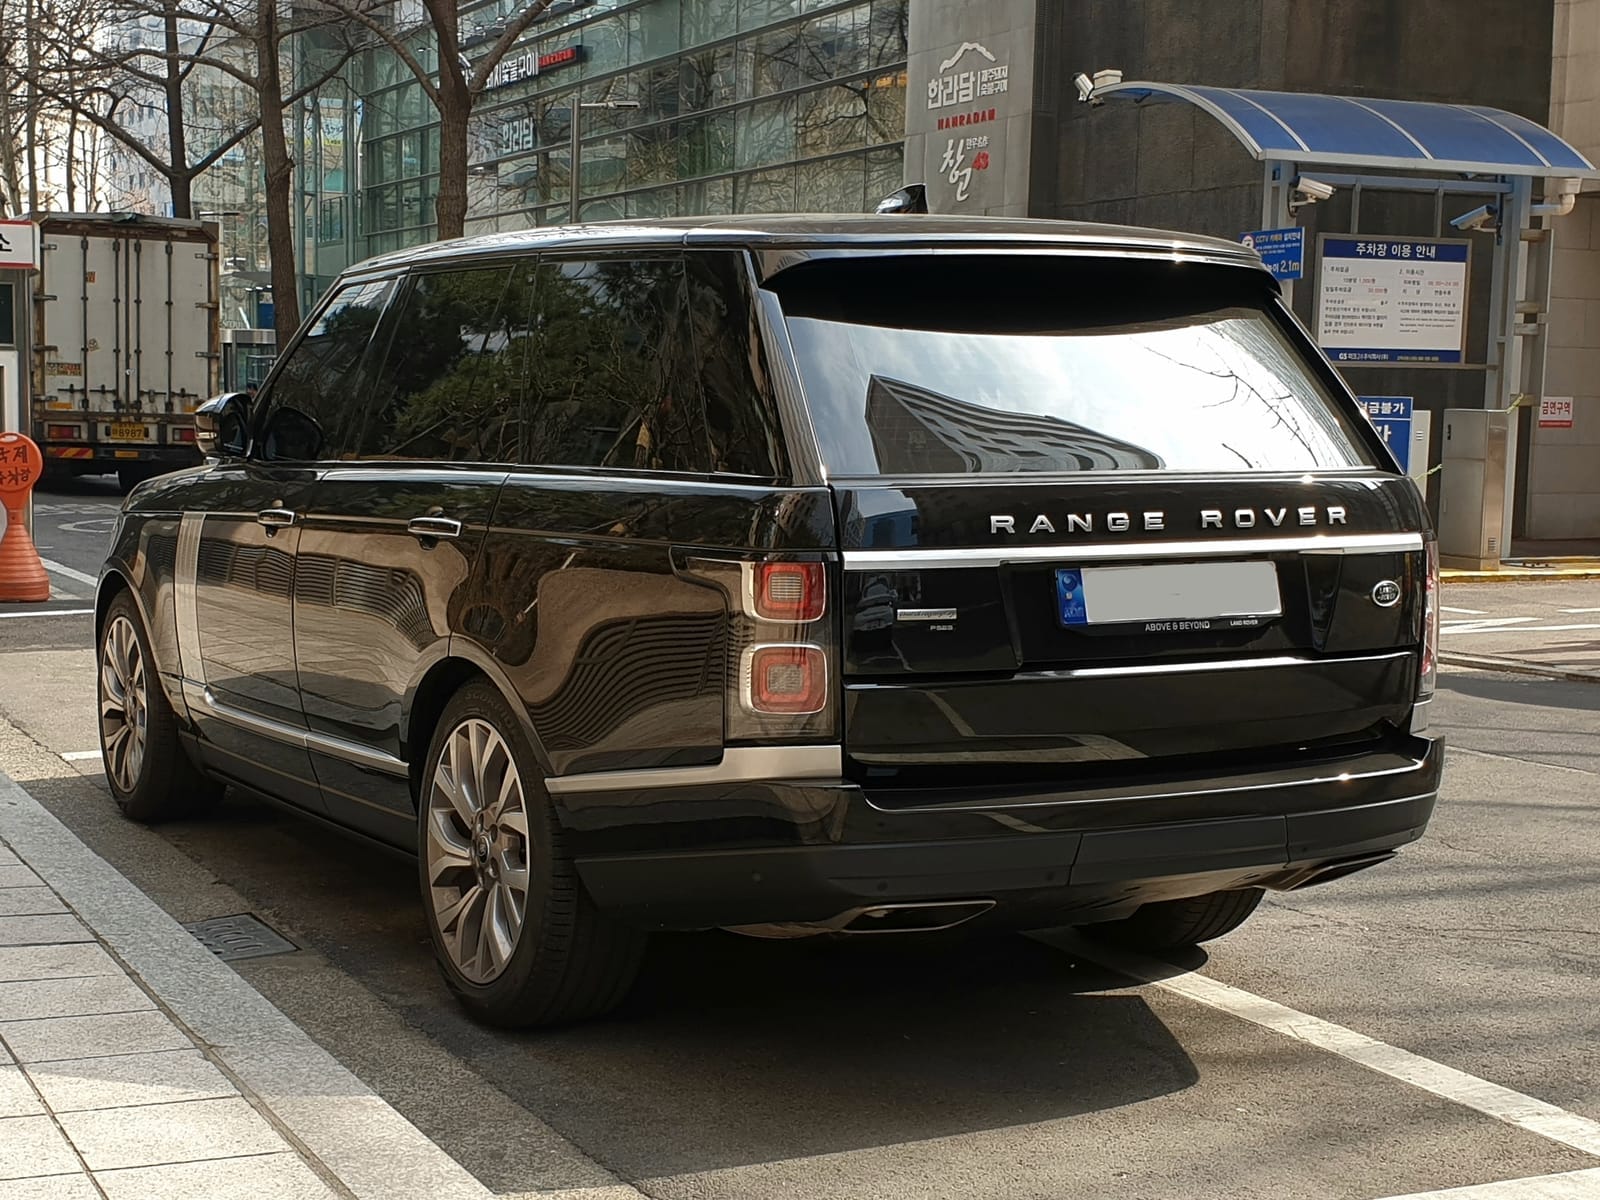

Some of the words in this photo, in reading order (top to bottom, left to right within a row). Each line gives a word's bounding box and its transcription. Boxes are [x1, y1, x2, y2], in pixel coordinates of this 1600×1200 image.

[927, 72, 975, 110] 한라담
[1356, 242, 1387, 257] 주차장
[1391, 244, 1412, 258] 이용
[1416, 245, 1436, 259] 안내
[1542, 401, 1571, 416] 금연구역
[989, 511, 1165, 535] RANGE
[1200, 506, 1348, 529] ROVER
[1145, 622, 1172, 632] ABOVE
[1179, 620, 1210, 630] BEYOND
